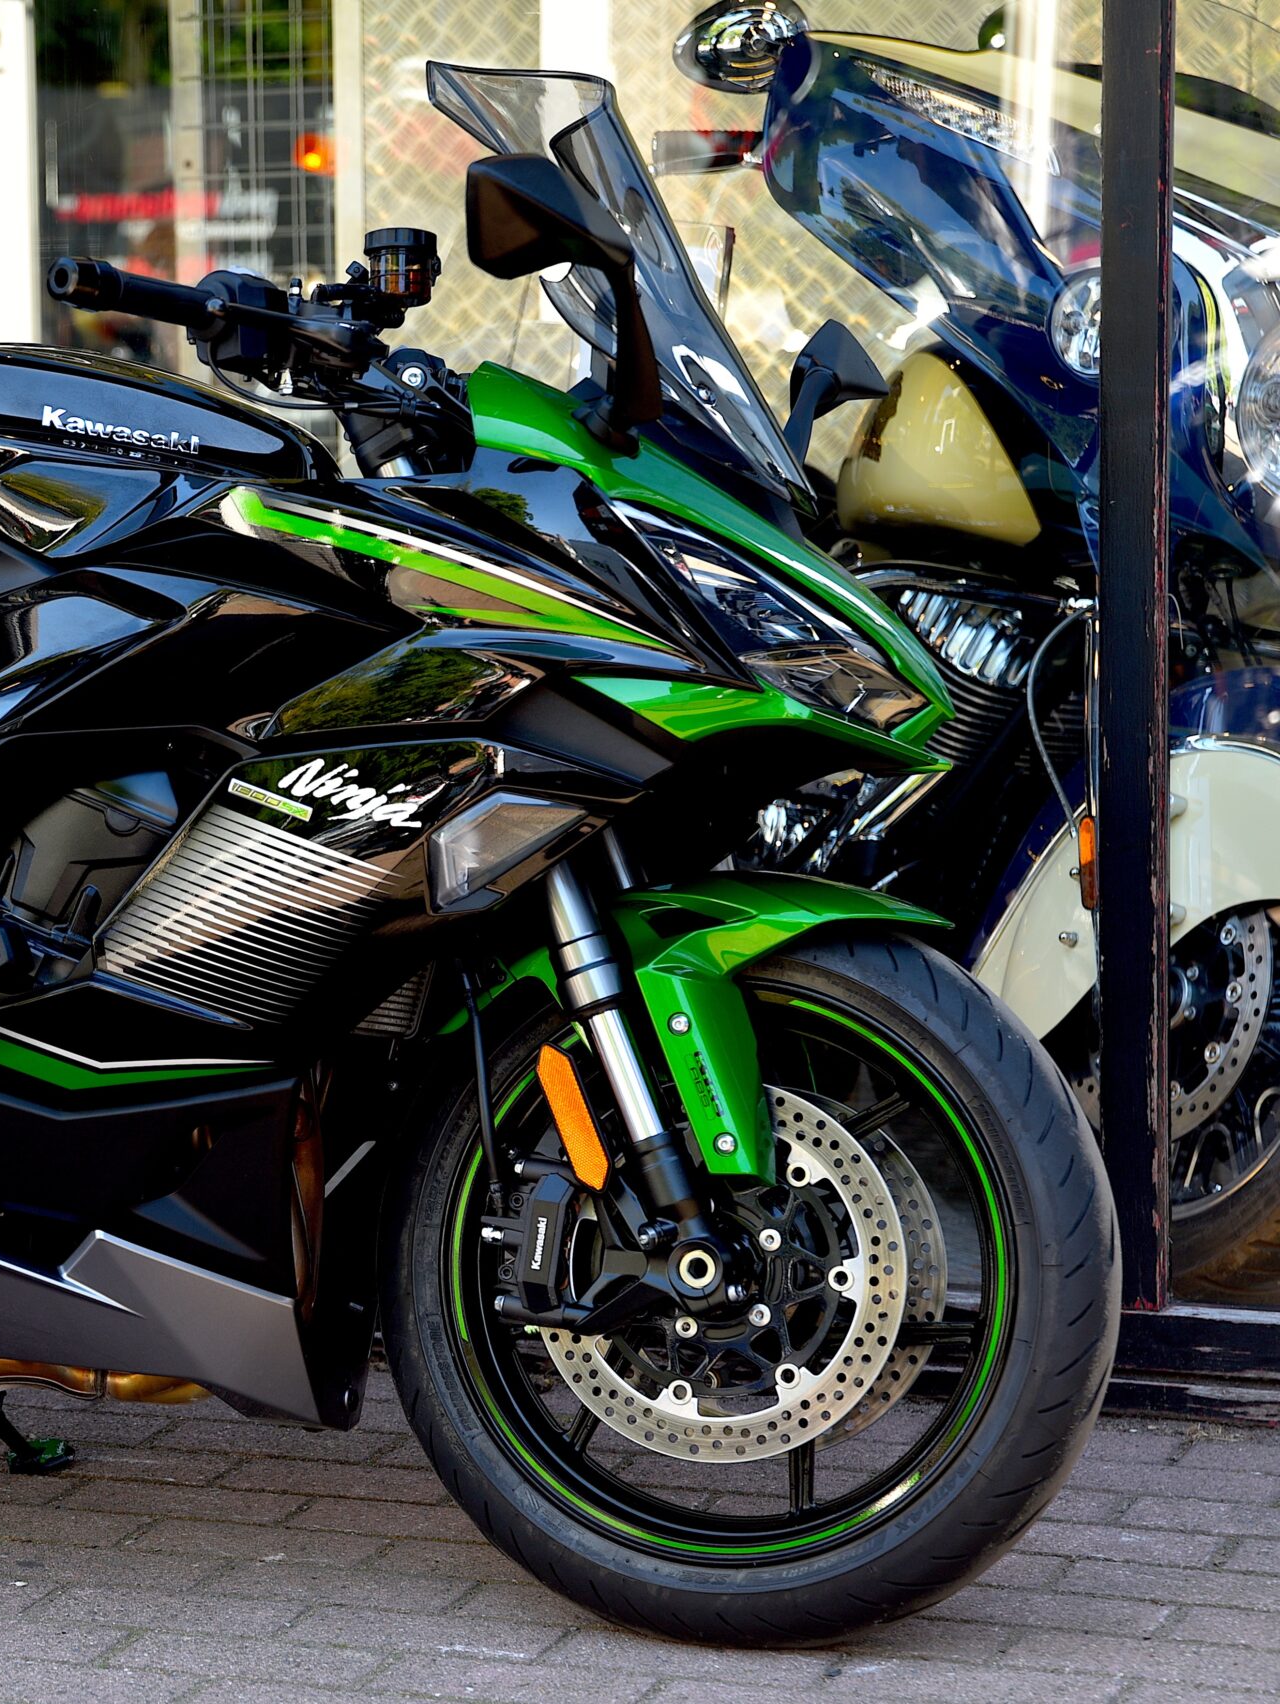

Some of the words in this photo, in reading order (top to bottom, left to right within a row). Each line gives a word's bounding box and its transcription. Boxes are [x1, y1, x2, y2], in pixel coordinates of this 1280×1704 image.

[42, 405, 199, 455] Kawasaki
[278, 758, 422, 828] Ninja
[531, 1216, 548, 1270] Kawasaki
